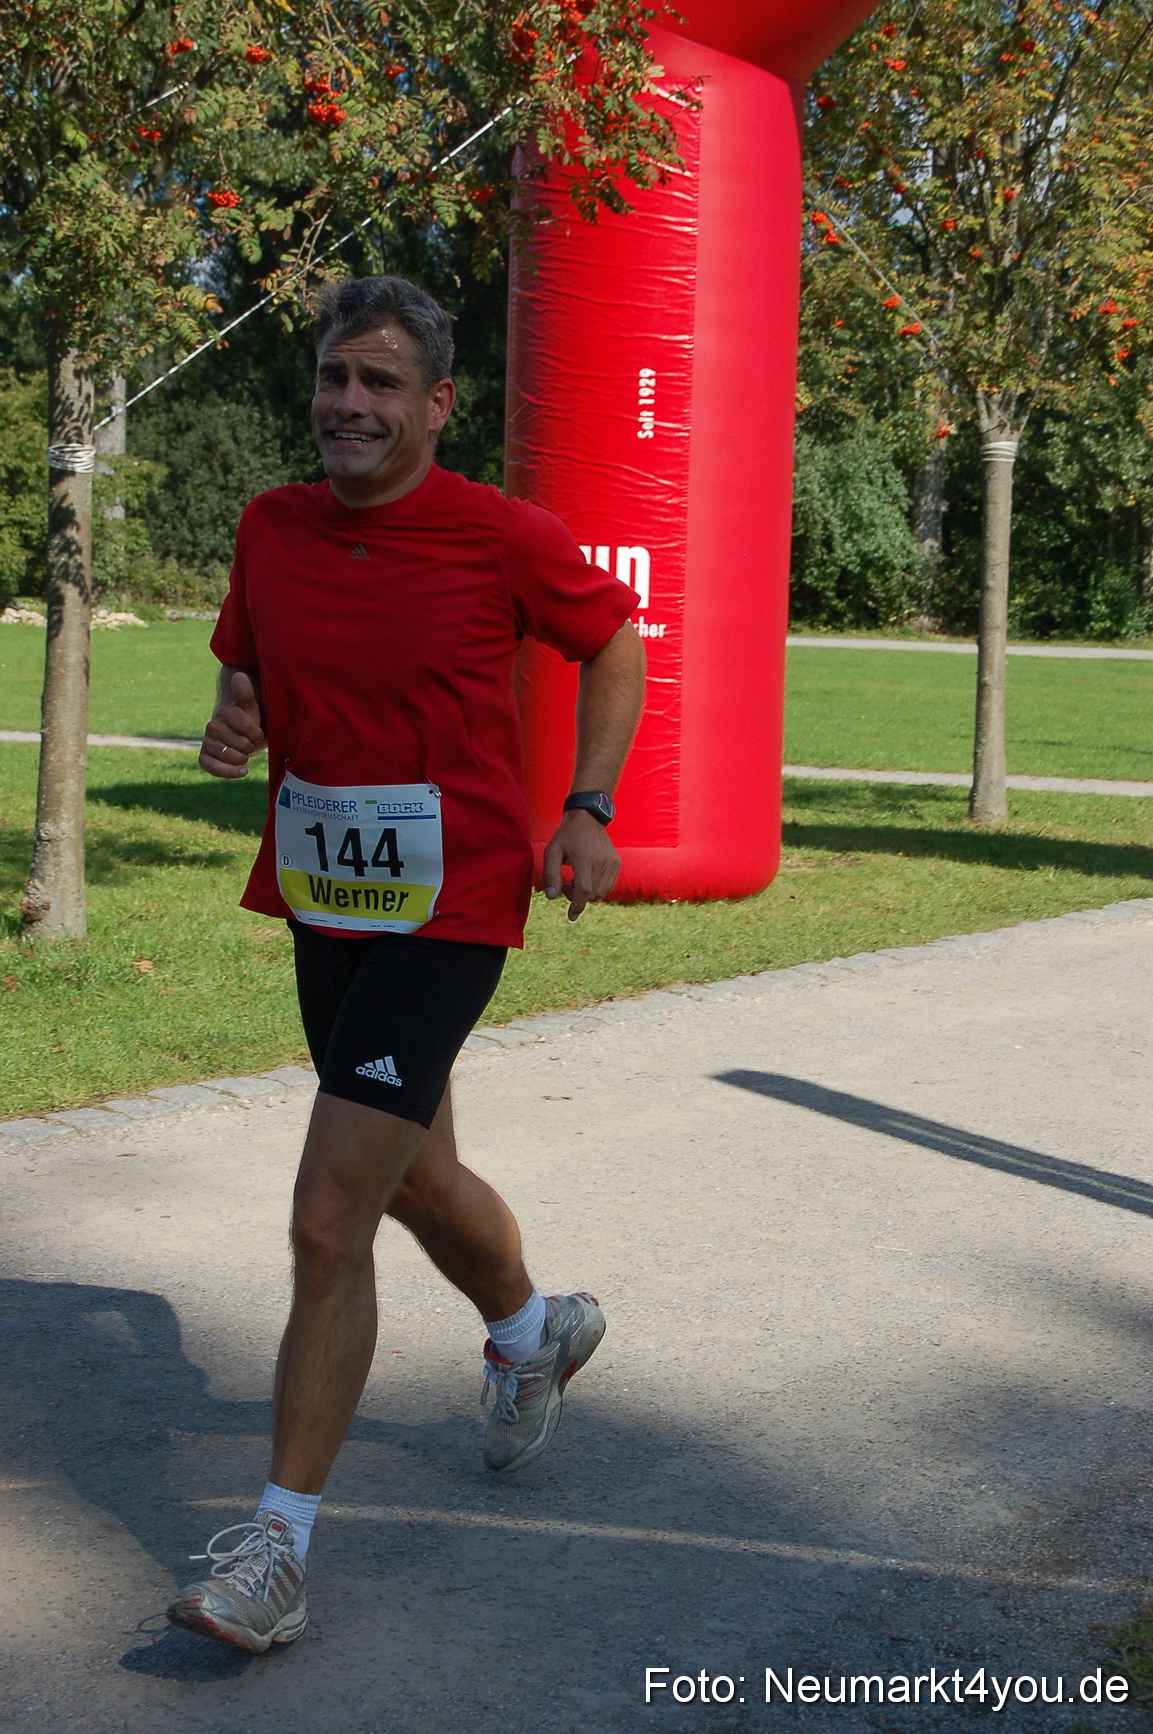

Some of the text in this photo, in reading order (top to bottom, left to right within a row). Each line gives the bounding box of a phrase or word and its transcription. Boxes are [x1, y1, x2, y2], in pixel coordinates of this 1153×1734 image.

[637, 367, 656, 439] Seit 1929
[292, 791, 358, 813] PFLEIDERER
[377, 802, 424, 814] BOCK
[292, 807, 359, 821] AKTIENGESELLSCHAFT
[305, 822, 405, 877] 144
[283, 856, 289, 866] D
[308, 875, 409, 912] Werner
[355, 1066, 402, 1087] adidas
